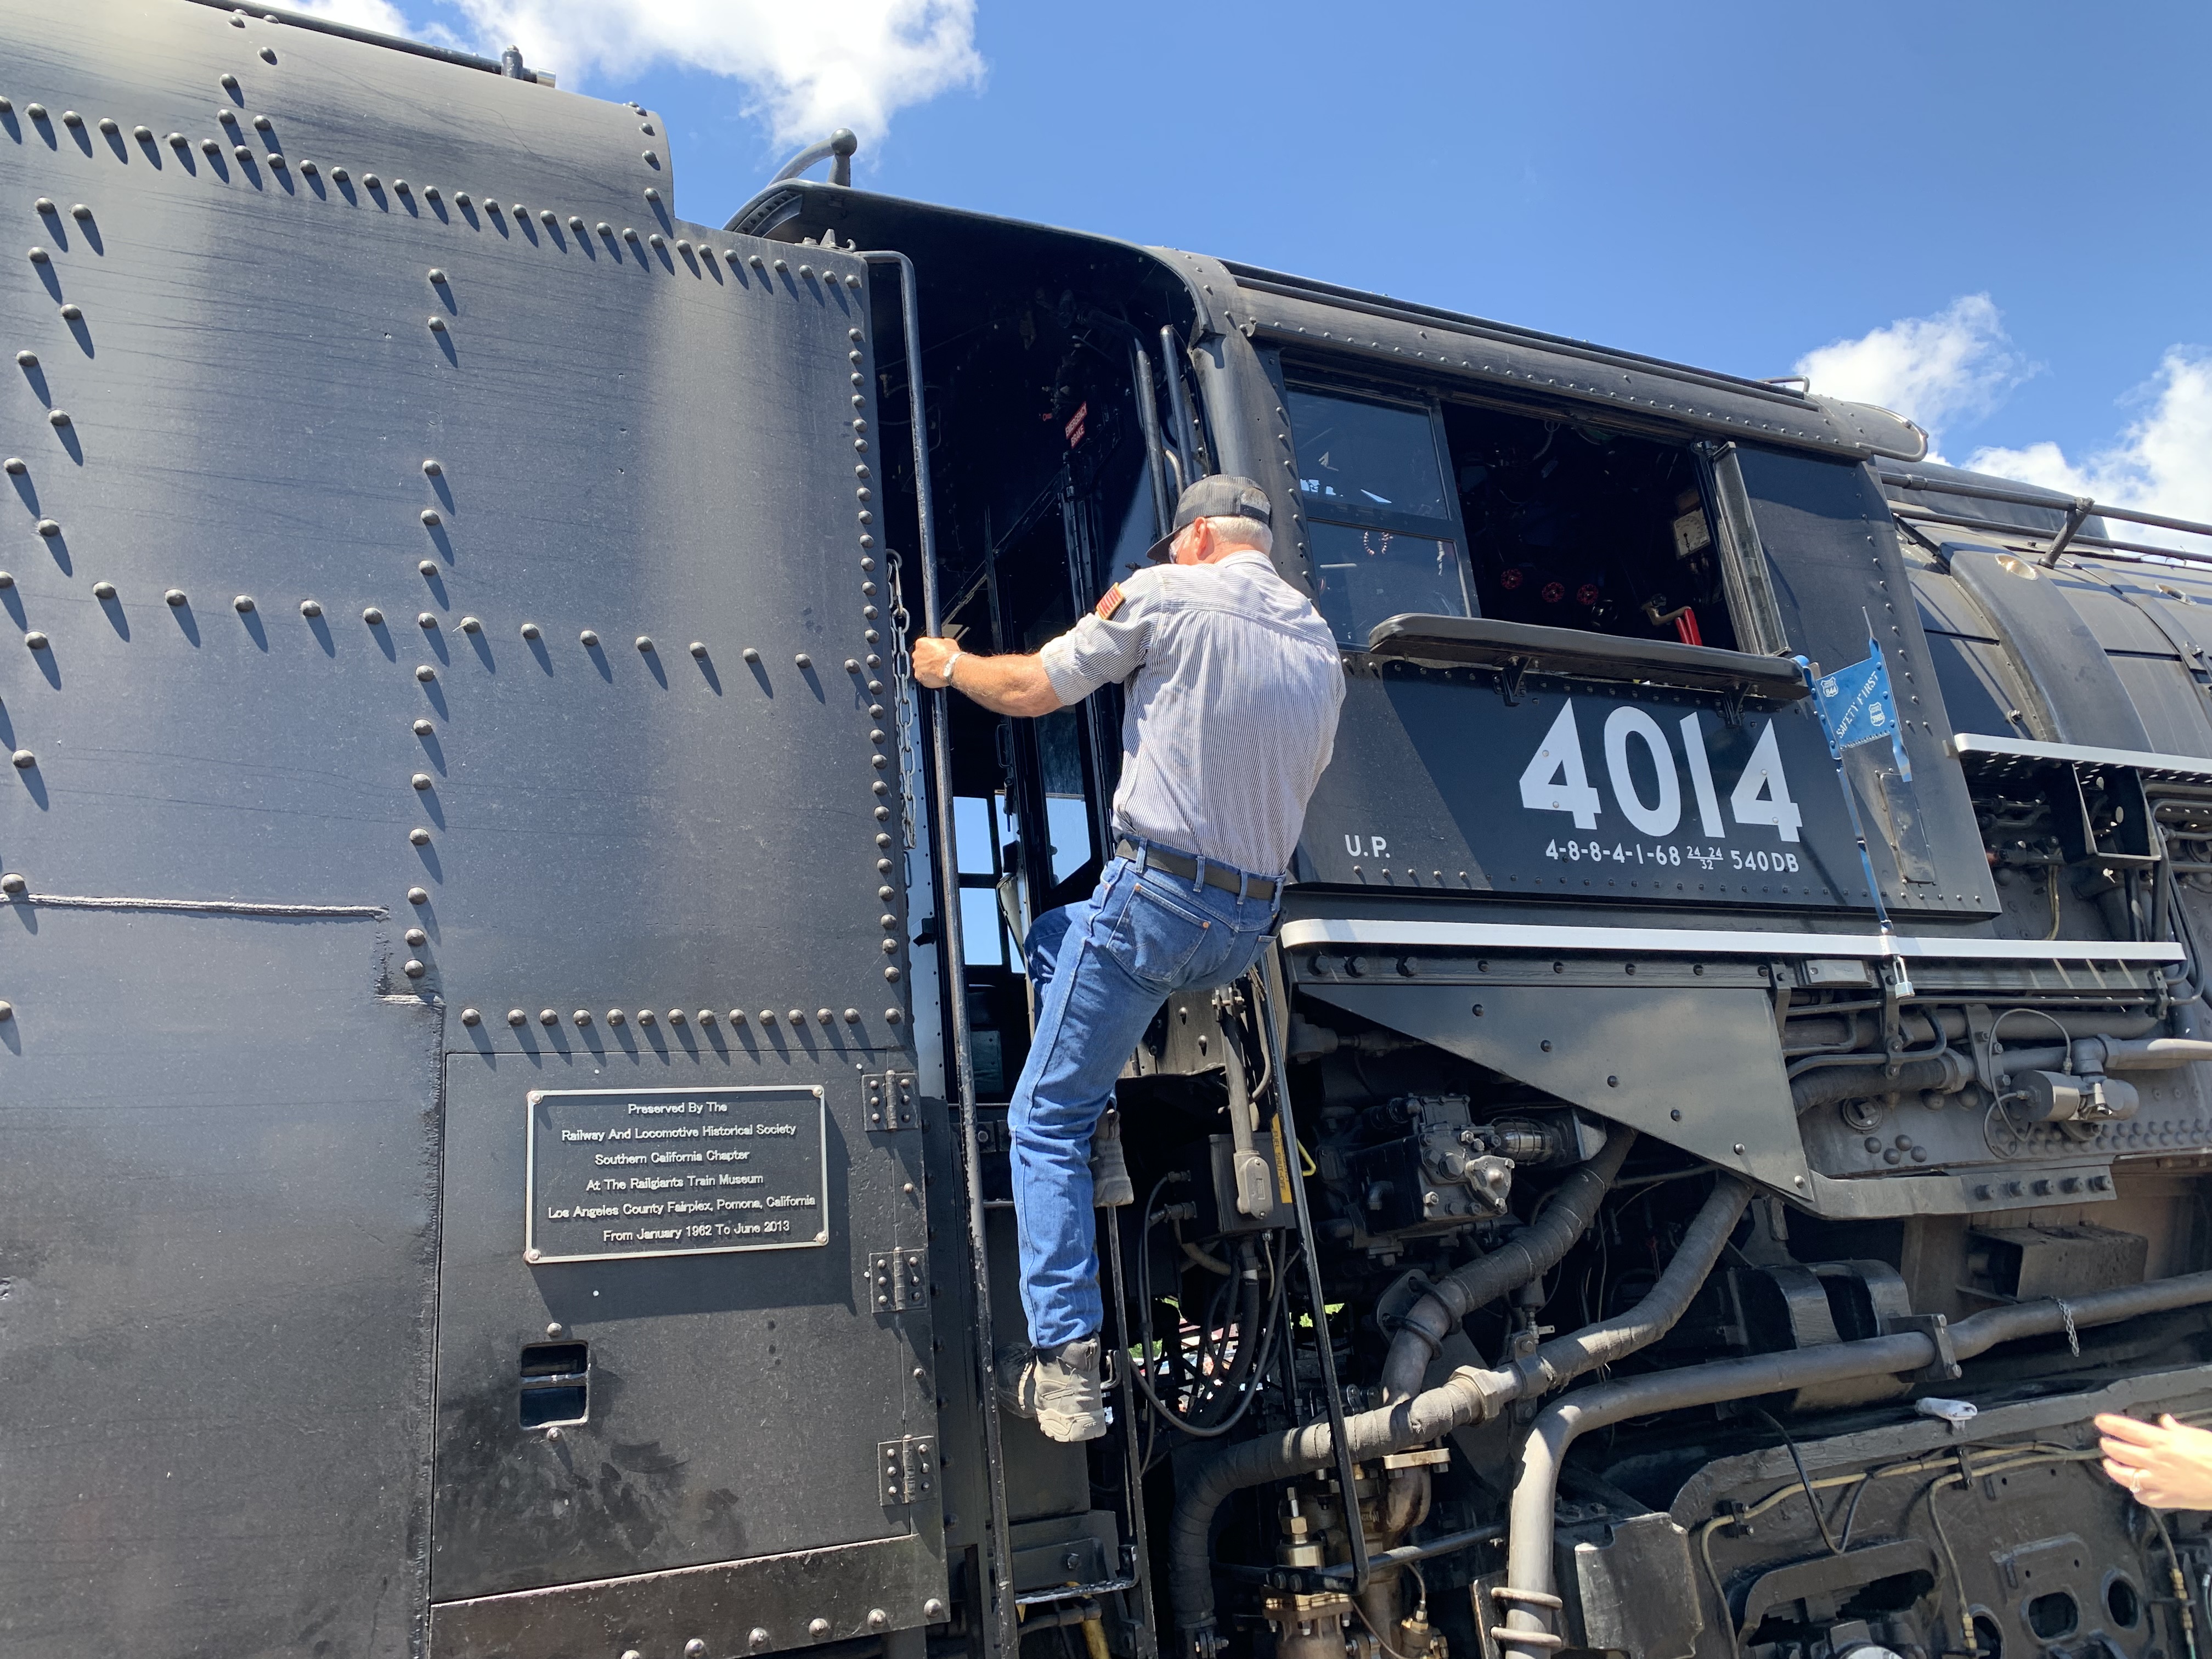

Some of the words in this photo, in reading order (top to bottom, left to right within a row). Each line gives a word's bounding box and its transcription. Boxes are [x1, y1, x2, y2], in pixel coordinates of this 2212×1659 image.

[1065, 403, 1086, 438] EMERGENCY
[1071, 424, 1085, 447] BRAKE
[1836, 702, 1858, 738] SAFETY
[1857, 671, 1878, 705] FIRST
[1519, 697, 1802, 842] 4014
[1345, 834, 1390, 858] U.P.
[1545, 839, 1680, 866] 4-8-8-4-1-68
[1700, 859, 1714, 870] 32
[628, 1103, 685, 1114] Preserved
[689, 1102, 703, 1114] By
[706, 1102, 727, 1112] The
[562, 1129, 605, 1142] Railway
[608, 1128, 631, 1139] And
[635, 1126, 699, 1138] Locomotive
[703, 1125, 753, 1136] Historical
[757, 1124, 796, 1135] Society
[595, 1153, 647, 1165] Southern
[651, 1150, 702, 1163] California
[707, 1150, 750, 1161] Chapter
[586, 1180, 601, 1191] At
[604, 1178, 626, 1190] The
[631, 1177, 684, 1190] Railgiants
[687, 1175, 715, 1187] Train
[719, 1174, 763, 1185] Museum
[1276, 1152, 1285, 1190] SHUT-OFF
[548, 1207, 569, 1218] Los
[573, 1205, 619, 1218] Angeles
[623, 1203, 664, 1215] County
[668, 1201, 713, 1214] Fairplex,
[717, 1199, 763, 1210] Pomona,
[766, 1195, 816, 1207] California
[603, 1230, 633, 1242] From
[637, 1228, 682, 1240] January
[686, 1225, 712, 1237] 1962
[715, 1224, 730, 1235] To
[734, 1223, 760, 1234] June
[764, 1220, 789, 1233] 2013
